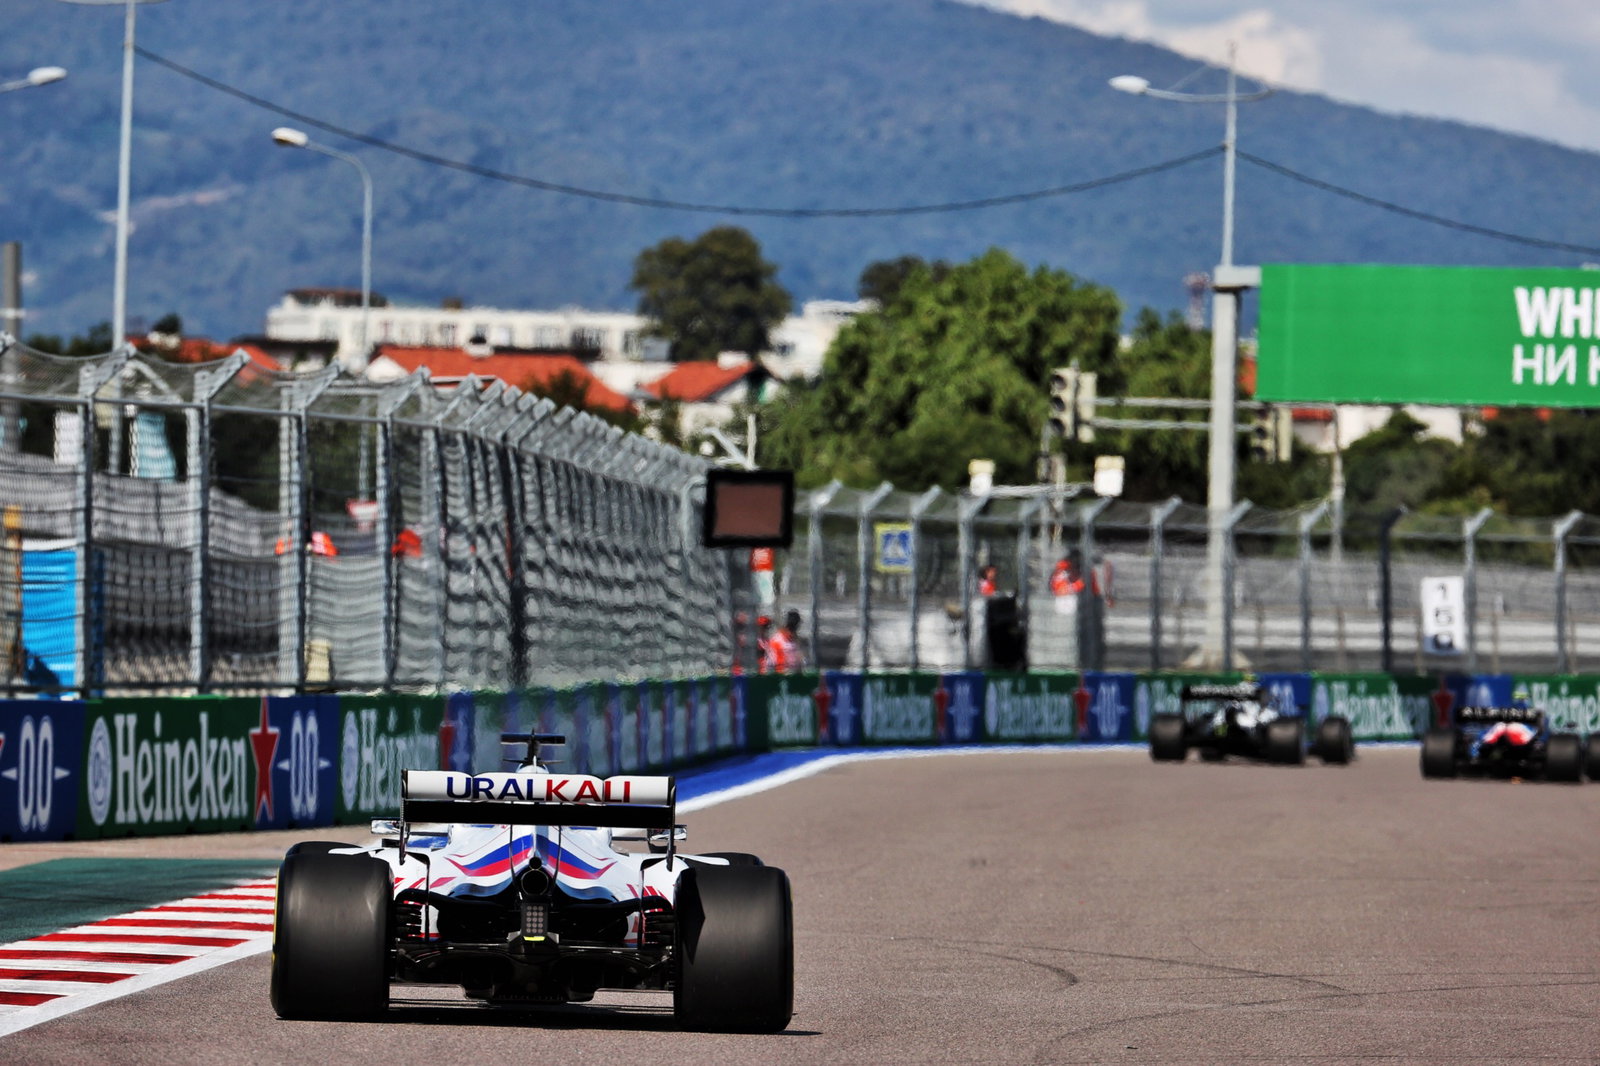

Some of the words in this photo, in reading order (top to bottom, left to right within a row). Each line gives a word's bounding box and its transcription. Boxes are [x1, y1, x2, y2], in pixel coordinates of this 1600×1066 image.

[1513, 286, 1600, 339] WH
[1512, 344, 1577, 385] НИ
[114, 711, 248, 824] Heineken
[447, 776, 631, 803] URALKALI
